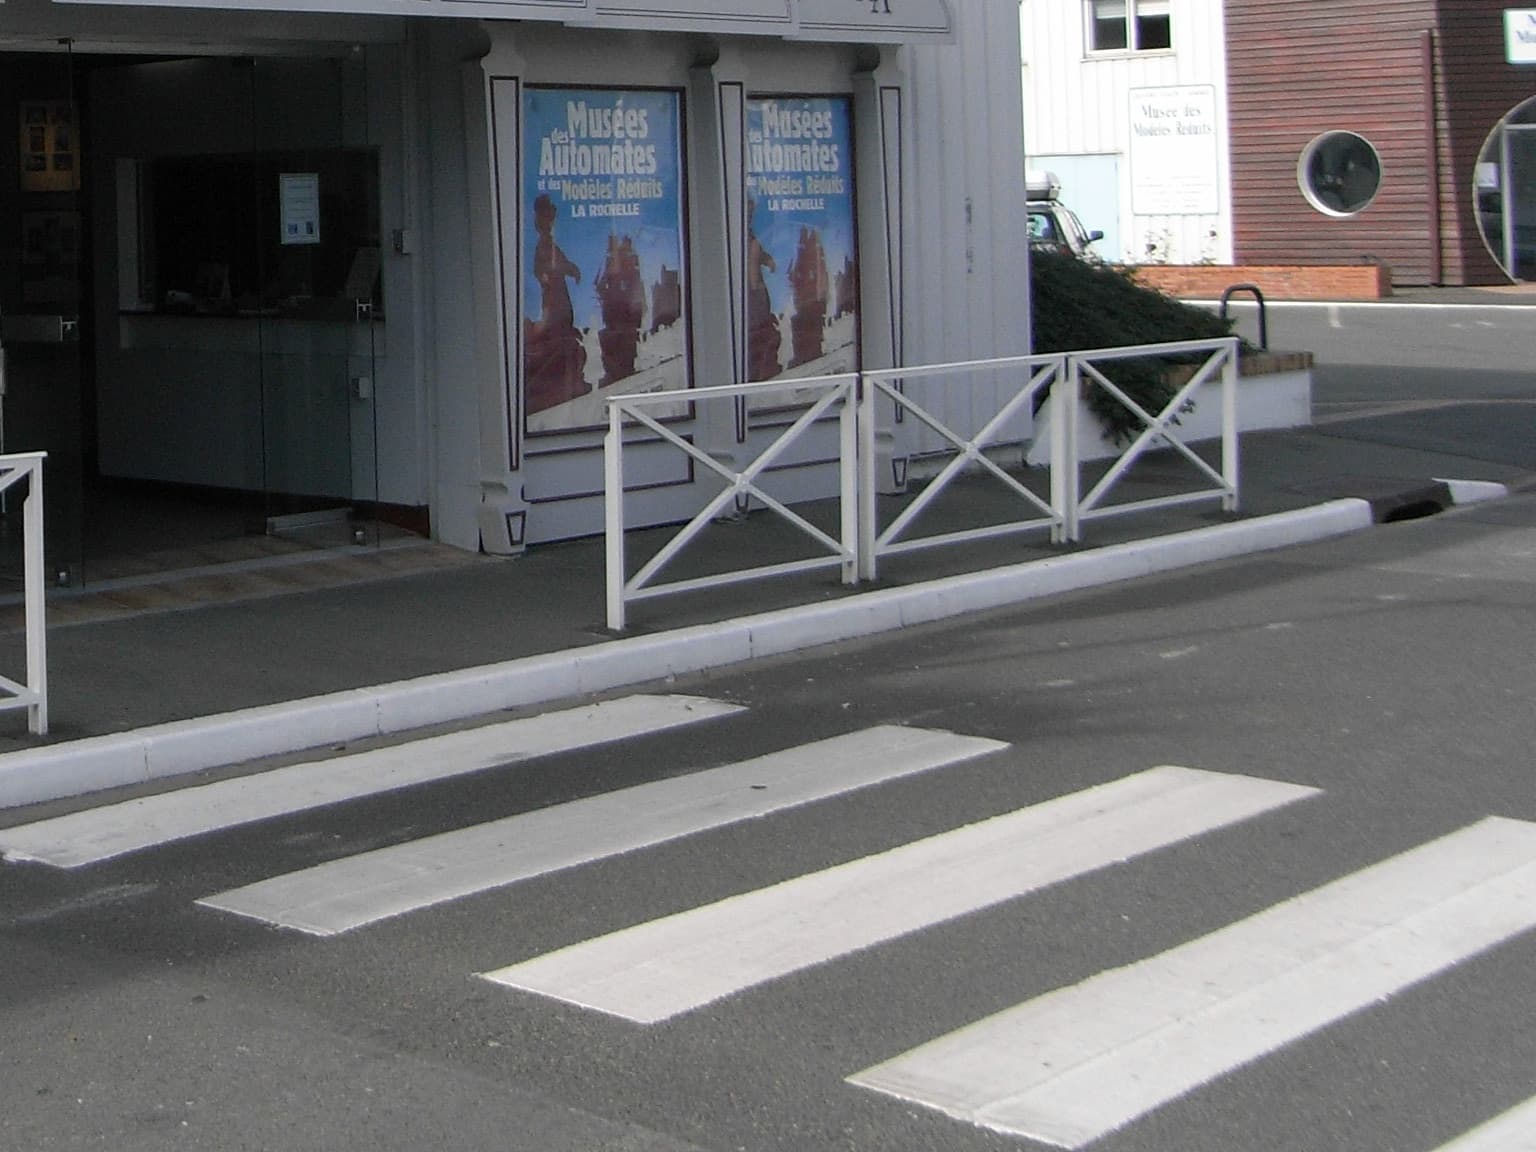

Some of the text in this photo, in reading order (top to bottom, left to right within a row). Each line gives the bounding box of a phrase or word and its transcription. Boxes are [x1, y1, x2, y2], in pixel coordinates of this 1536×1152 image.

[567, 97, 648, 139] Musées
[762, 102, 833, 139] Musées
[551, 128, 569, 144] des
[539, 137, 657, 176] Automates
[571, 202, 640, 217] LA ROCHELLE
[768, 199, 779, 211] LA
